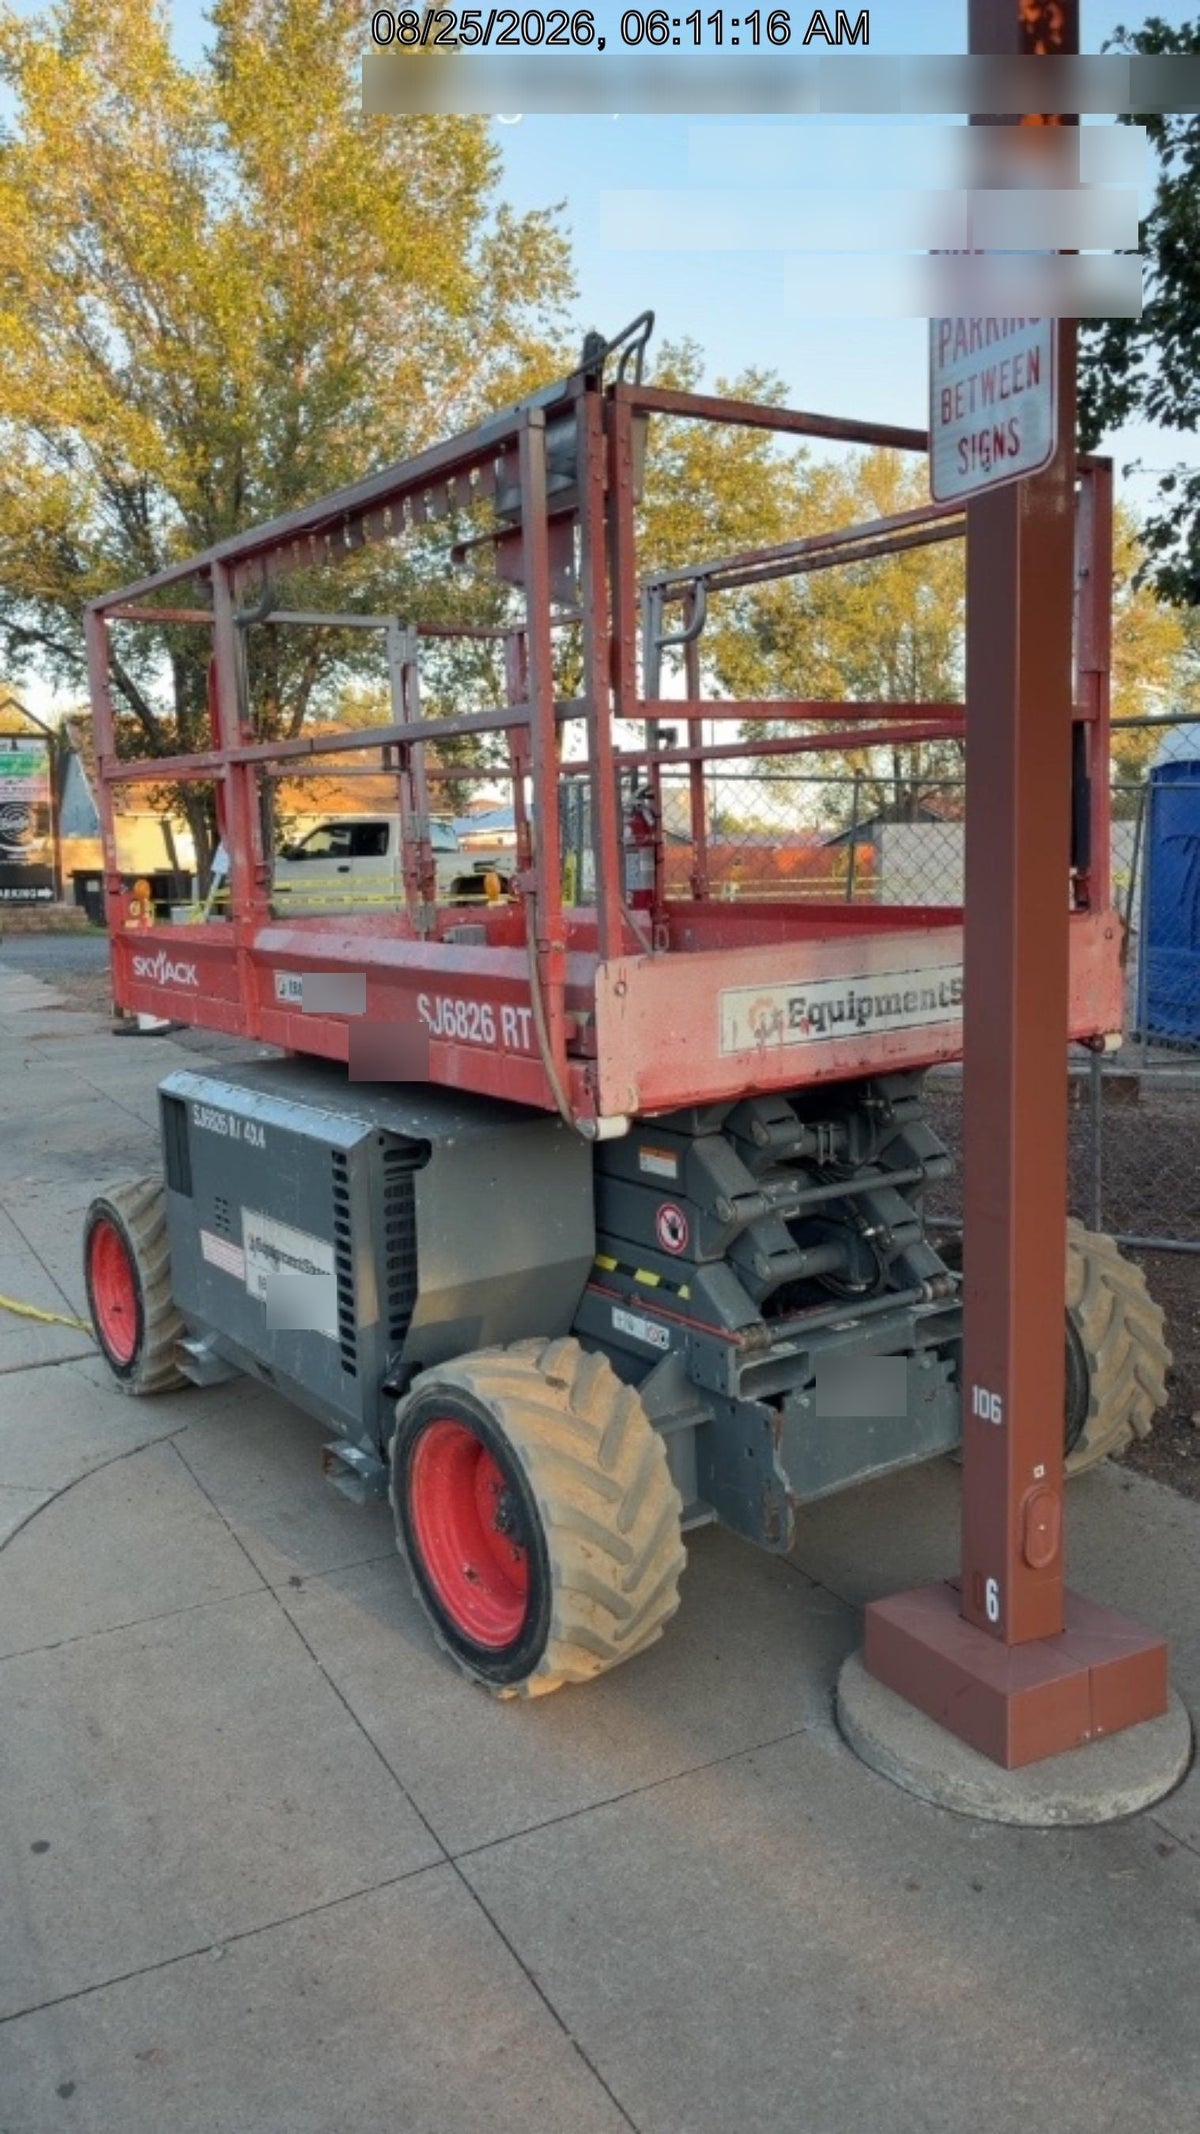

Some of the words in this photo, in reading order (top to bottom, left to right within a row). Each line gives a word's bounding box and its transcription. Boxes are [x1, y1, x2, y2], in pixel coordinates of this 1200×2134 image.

[938, 318, 1041, 368] PARK
[941, 346, 1040, 425] BETWEEN
[957, 417, 1020, 475] SIGNS
[132, 950, 199, 987] SKYJACK
[417, 993, 496, 1043] SJ6826
[501, 1005, 531, 1049] RT
[788, 977, 963, 1032] EquipmentS
[972, 1384, 1002, 1425] 106
[986, 1577, 999, 1622] 6
